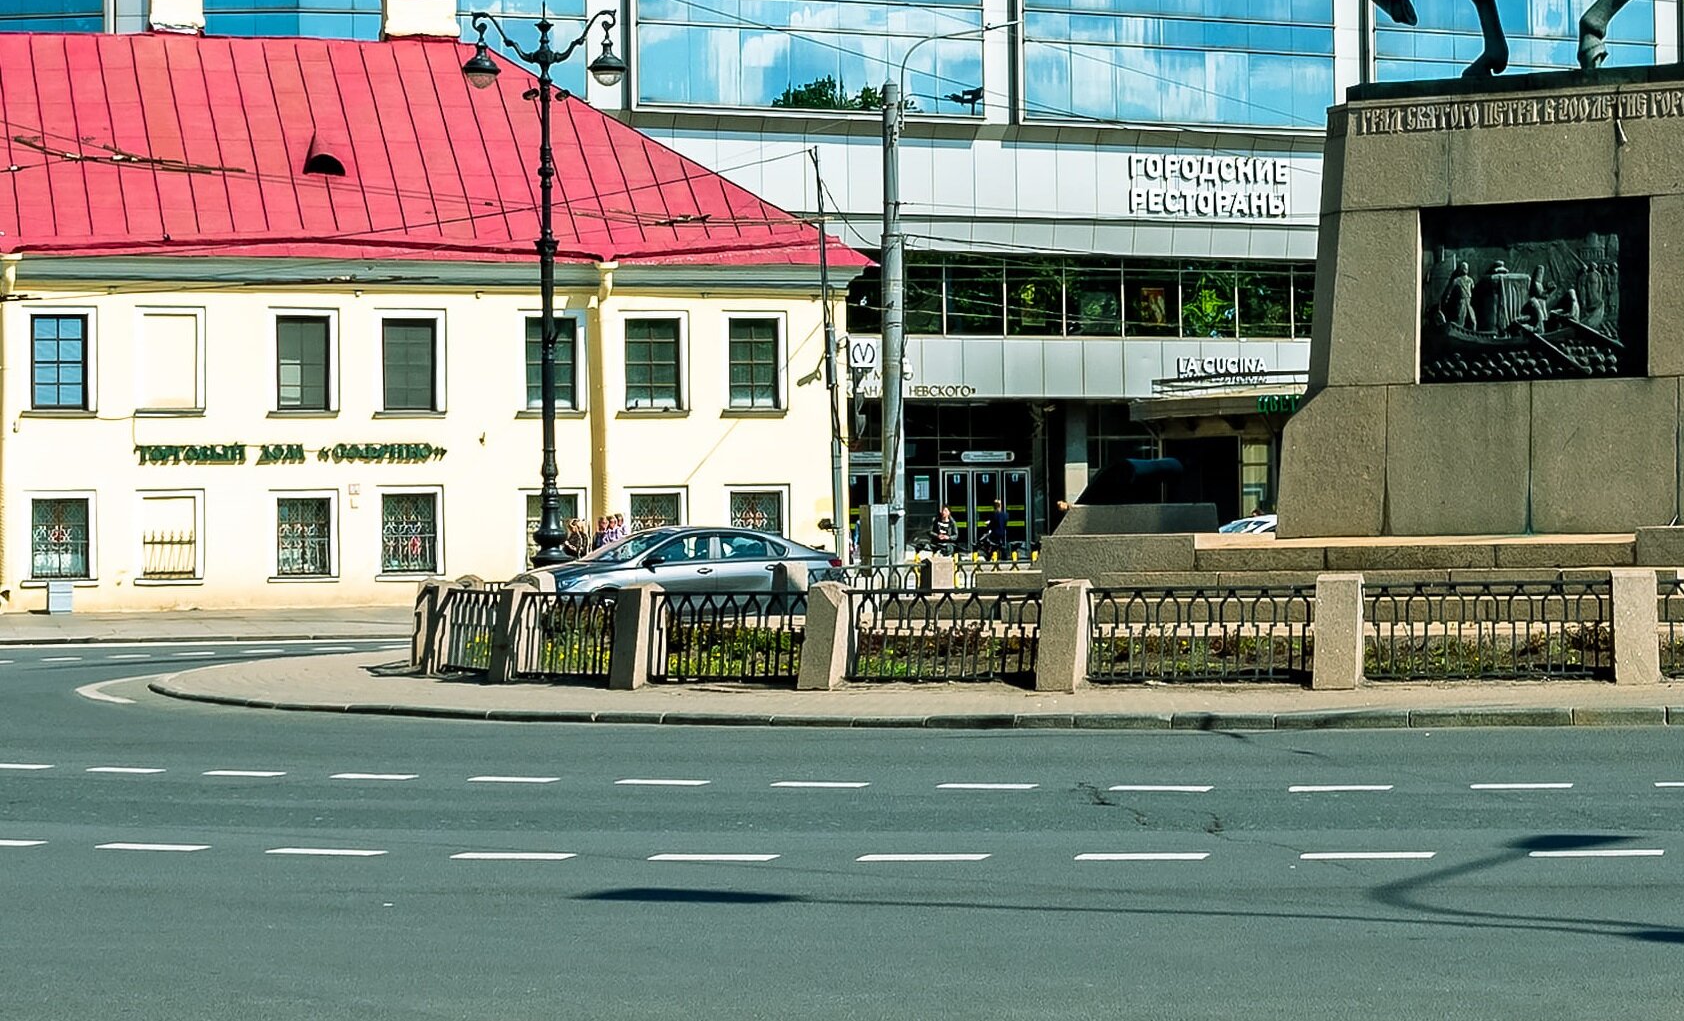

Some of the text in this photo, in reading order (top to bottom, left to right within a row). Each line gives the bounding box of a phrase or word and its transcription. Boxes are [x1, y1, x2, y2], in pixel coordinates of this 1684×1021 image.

[1128, 155, 1288, 186] ГОРОДСКИЕ
[1129, 188, 1288, 218] РЕСТОРАНЫ
[1178, 356, 1268, 375] LA CUCINA
[256, 443, 306, 465] ДОМ
